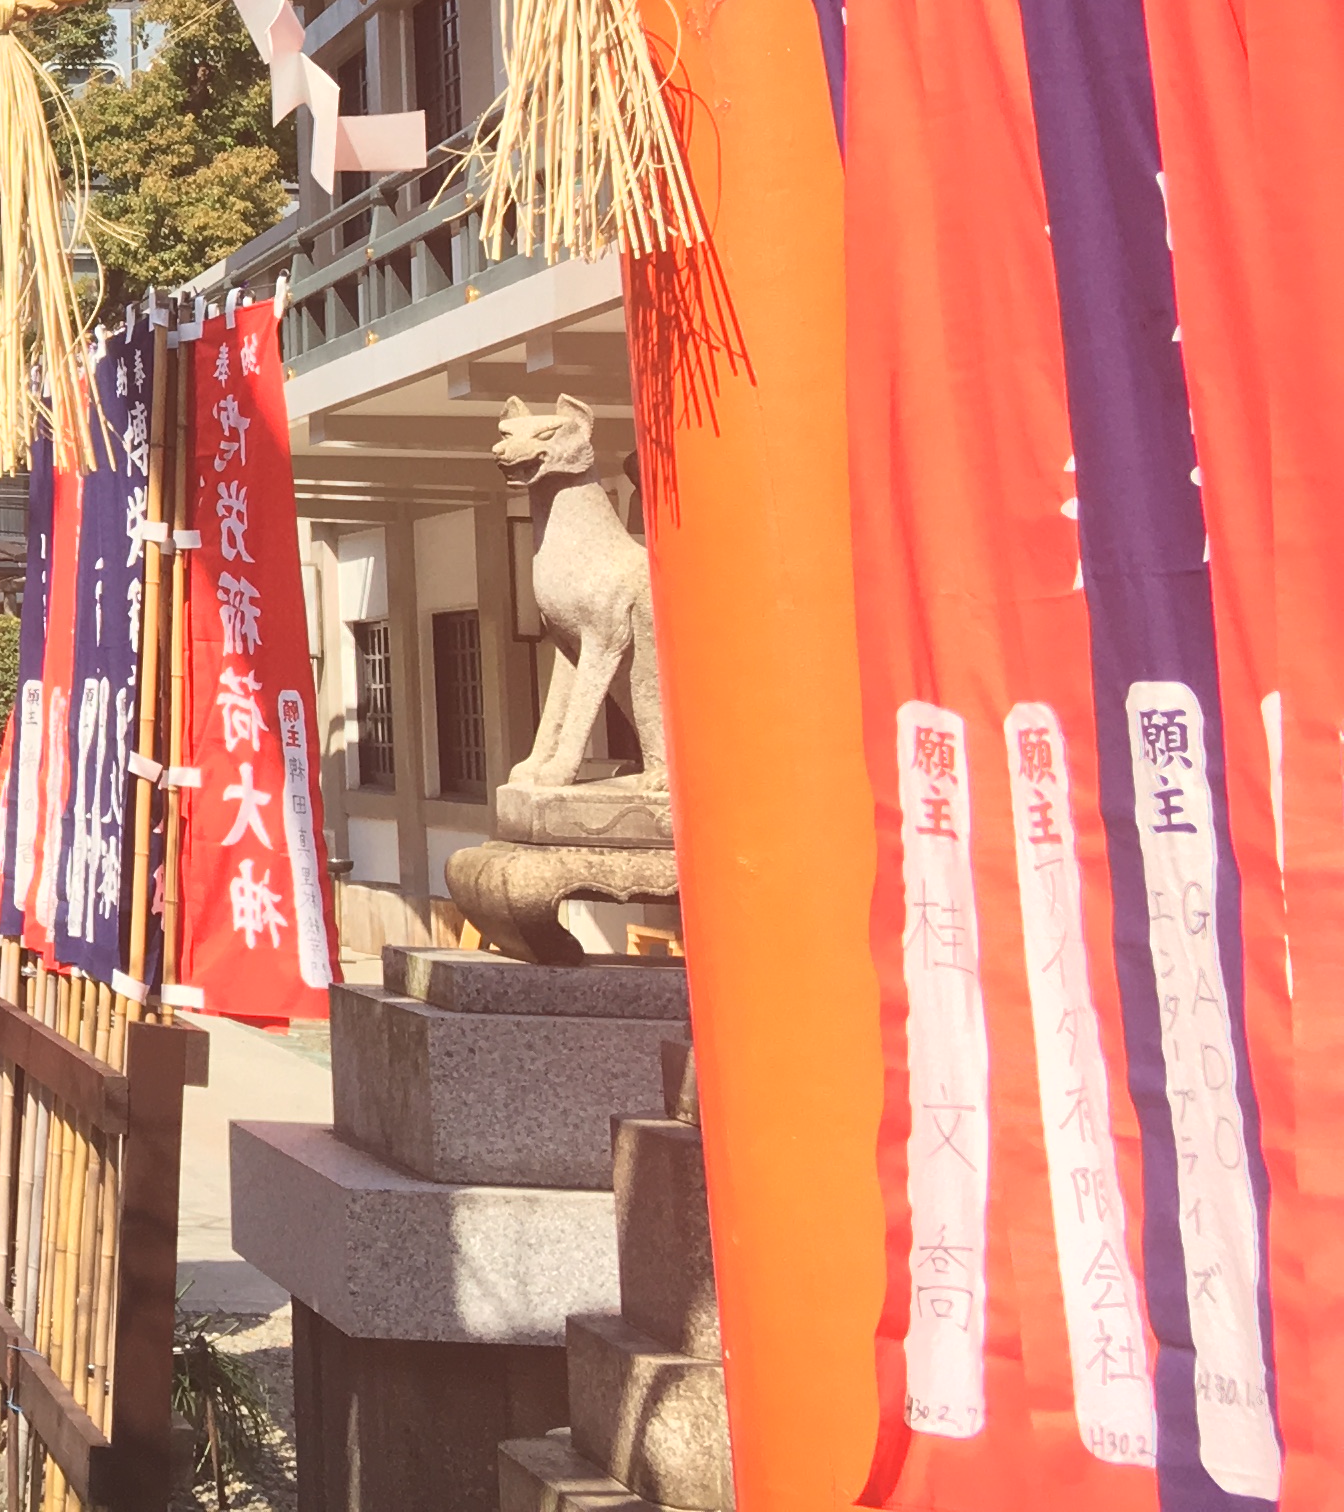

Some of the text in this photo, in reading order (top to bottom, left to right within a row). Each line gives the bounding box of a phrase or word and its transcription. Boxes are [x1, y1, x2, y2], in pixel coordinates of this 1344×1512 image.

[912, 724, 959, 842] 願主
[1017, 727, 1062, 847] 願主
[1140, 707, 1197, 836] 願主
